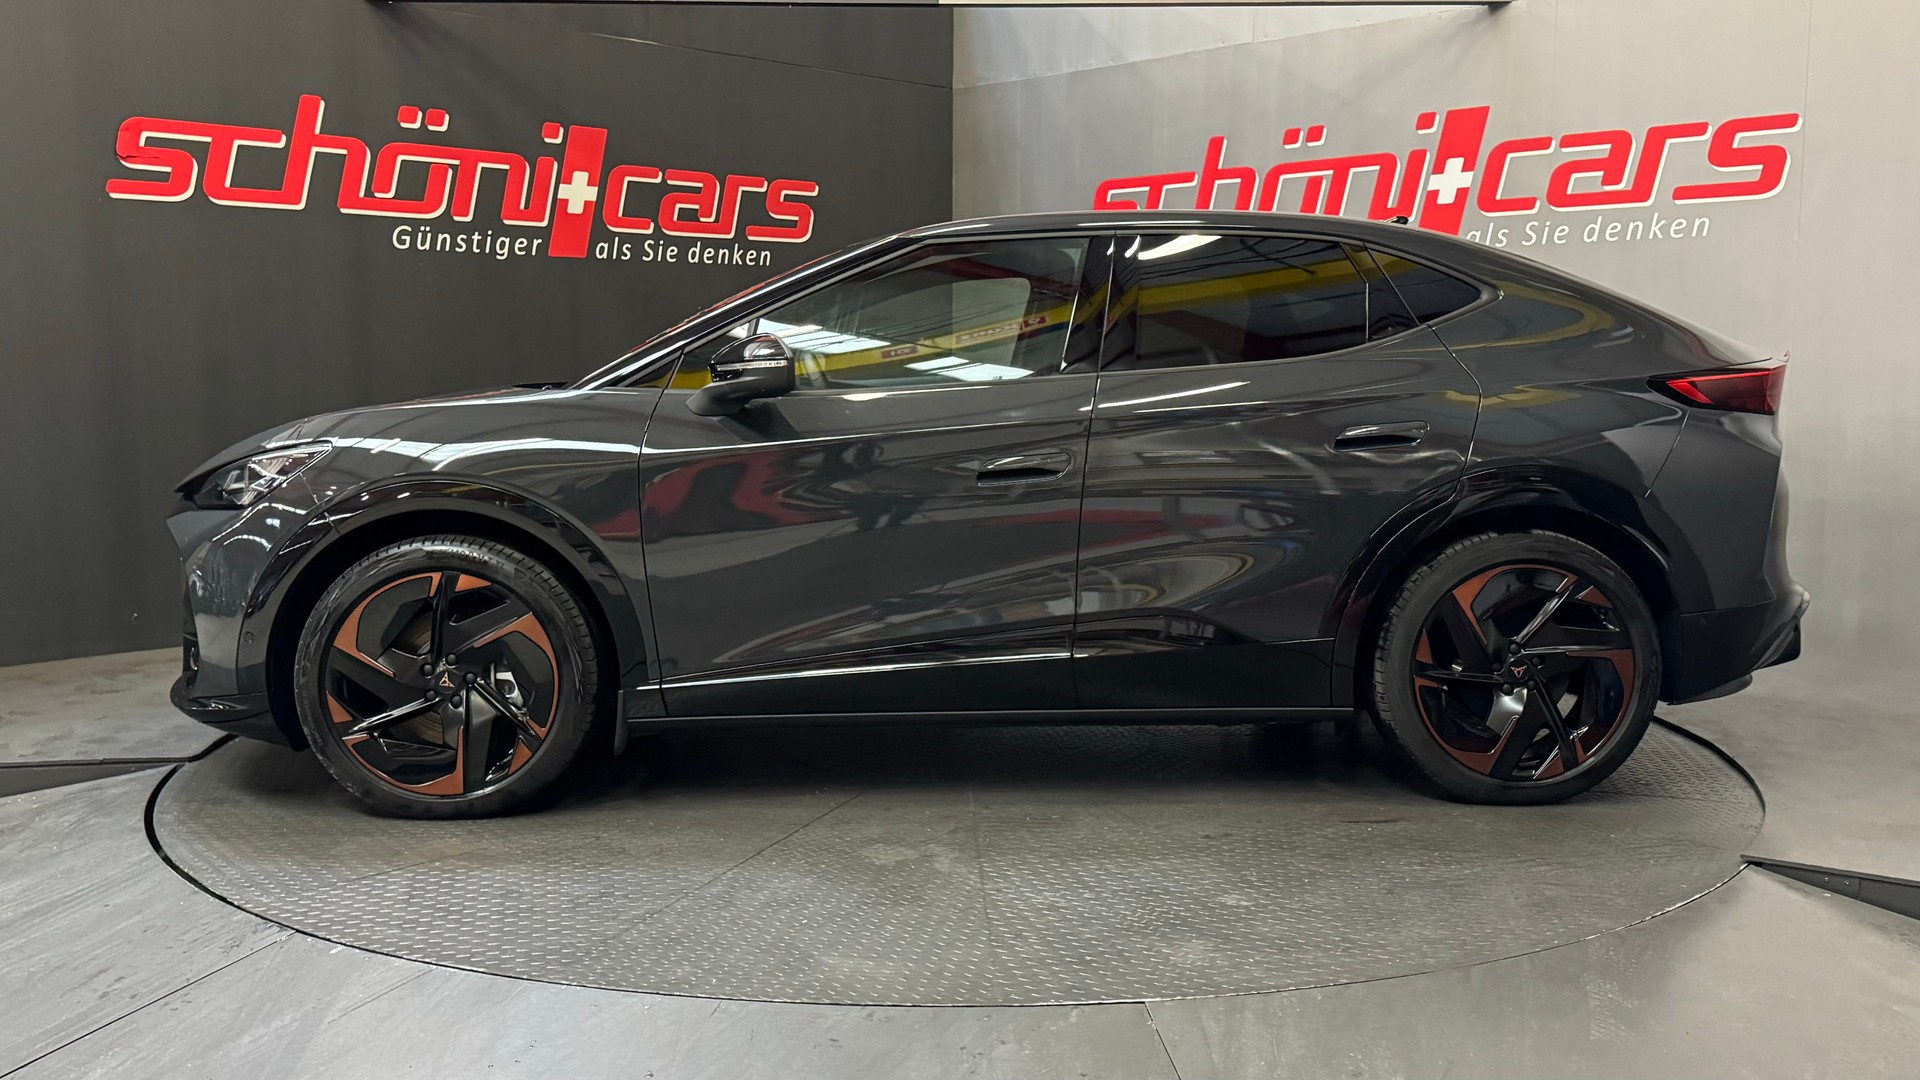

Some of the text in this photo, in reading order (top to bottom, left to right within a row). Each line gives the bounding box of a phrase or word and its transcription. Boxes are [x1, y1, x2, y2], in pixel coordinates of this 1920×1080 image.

[392, 225, 771, 266] Günstiger als Sie denken
[1465, 212, 1711, 247] als Sie denken
